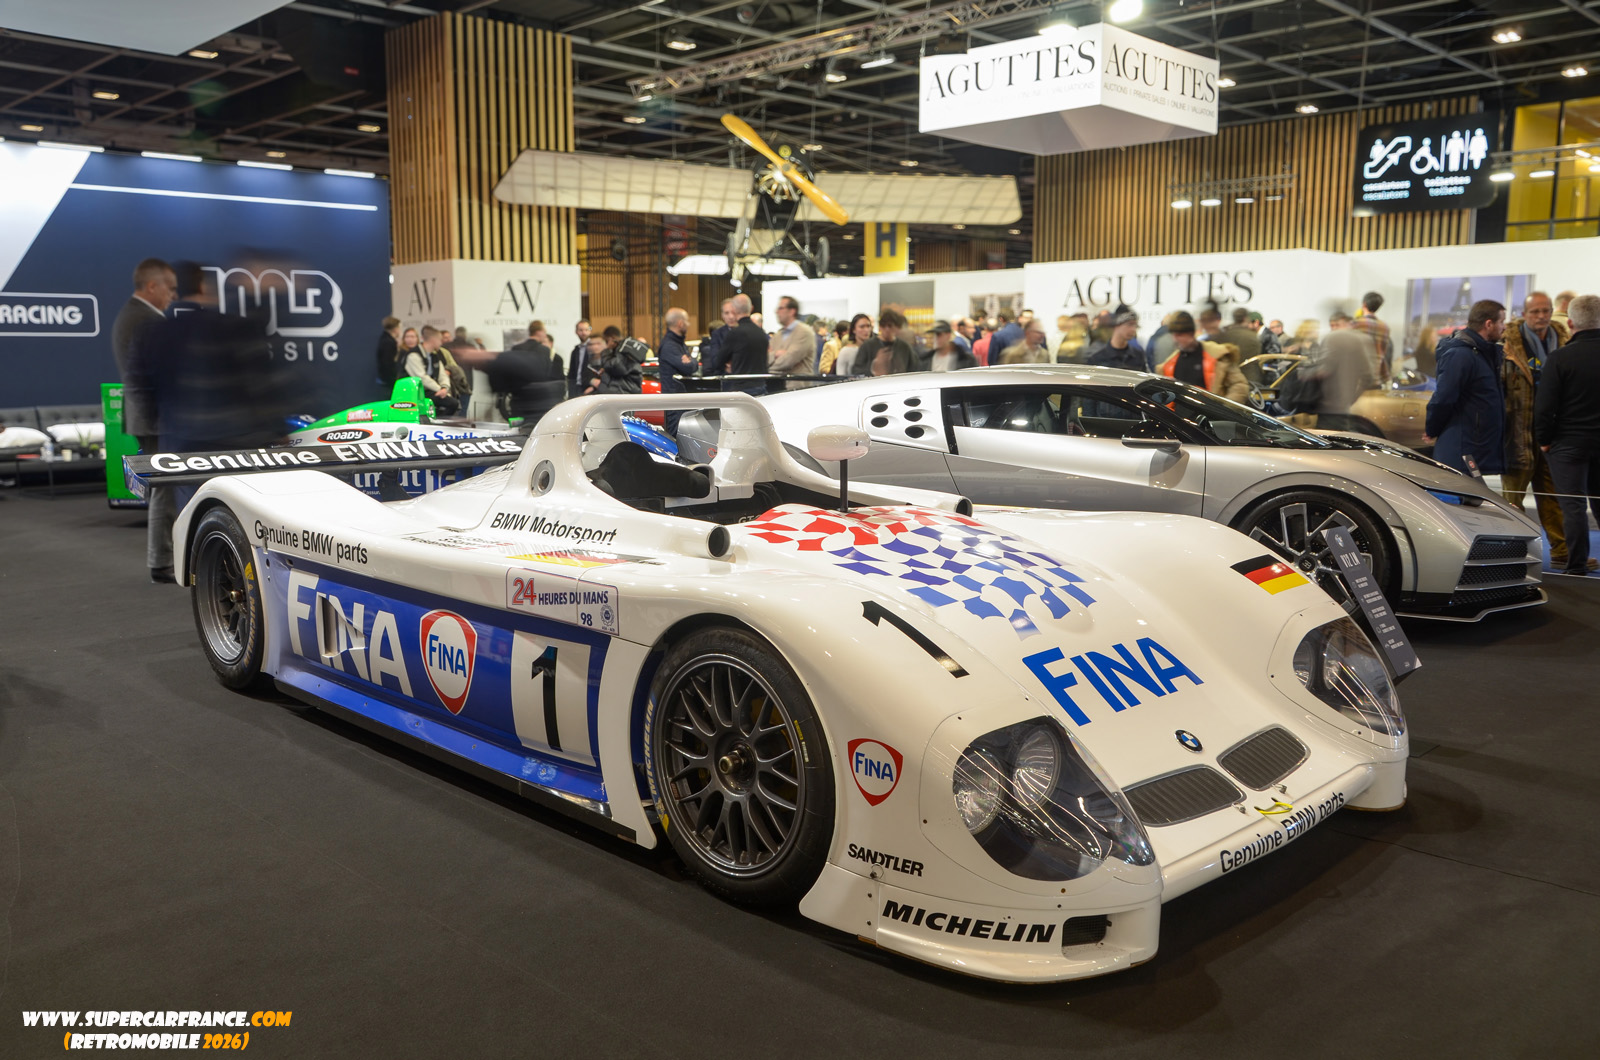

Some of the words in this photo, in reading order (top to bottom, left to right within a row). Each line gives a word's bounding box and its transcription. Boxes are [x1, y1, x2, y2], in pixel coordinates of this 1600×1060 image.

[925, 39, 1096, 102] AGUTTES
[1103, 82, 1128, 95] AUCTIONS
[1105, 42, 1216, 104] AGUTTES
[876, 221, 896, 258] H
[1063, 270, 1254, 309] AGUTTES
[0, 303, 83, 326] RACING
[150, 448, 321, 473] Genuine
[331, 439, 429, 462] BMW
[436, 437, 523, 456] parts
[409, 430, 427, 442] La
[254, 519, 299, 548] Genuine
[302, 528, 334, 556] BMW
[336, 540, 369, 565] parts
[490, 512, 530, 531] BMW
[529, 514, 618, 546] Motorsport
[512, 577, 537, 606] 24
[538, 591, 568, 605] HEURES
[569, 591, 582, 605] DU
[583, 590, 609, 604] MANS
[287, 568, 414, 698] FINA
[580, 612, 593, 627] 98
[861, 600, 970, 679] 1
[428, 634, 468, 678] FINA
[531, 645, 563, 752] 1
[1022, 637, 1204, 727] FINA
[643, 699, 658, 796] MICHELIN
[855, 751, 894, 782] FINA
[1220, 831, 1282, 873] Genuine
[1281, 805, 1316, 840] BMW
[1319, 791, 1345, 821] parts
[847, 843, 924, 878] SANDTLER
[882, 899, 1056, 944] MICHELIN
